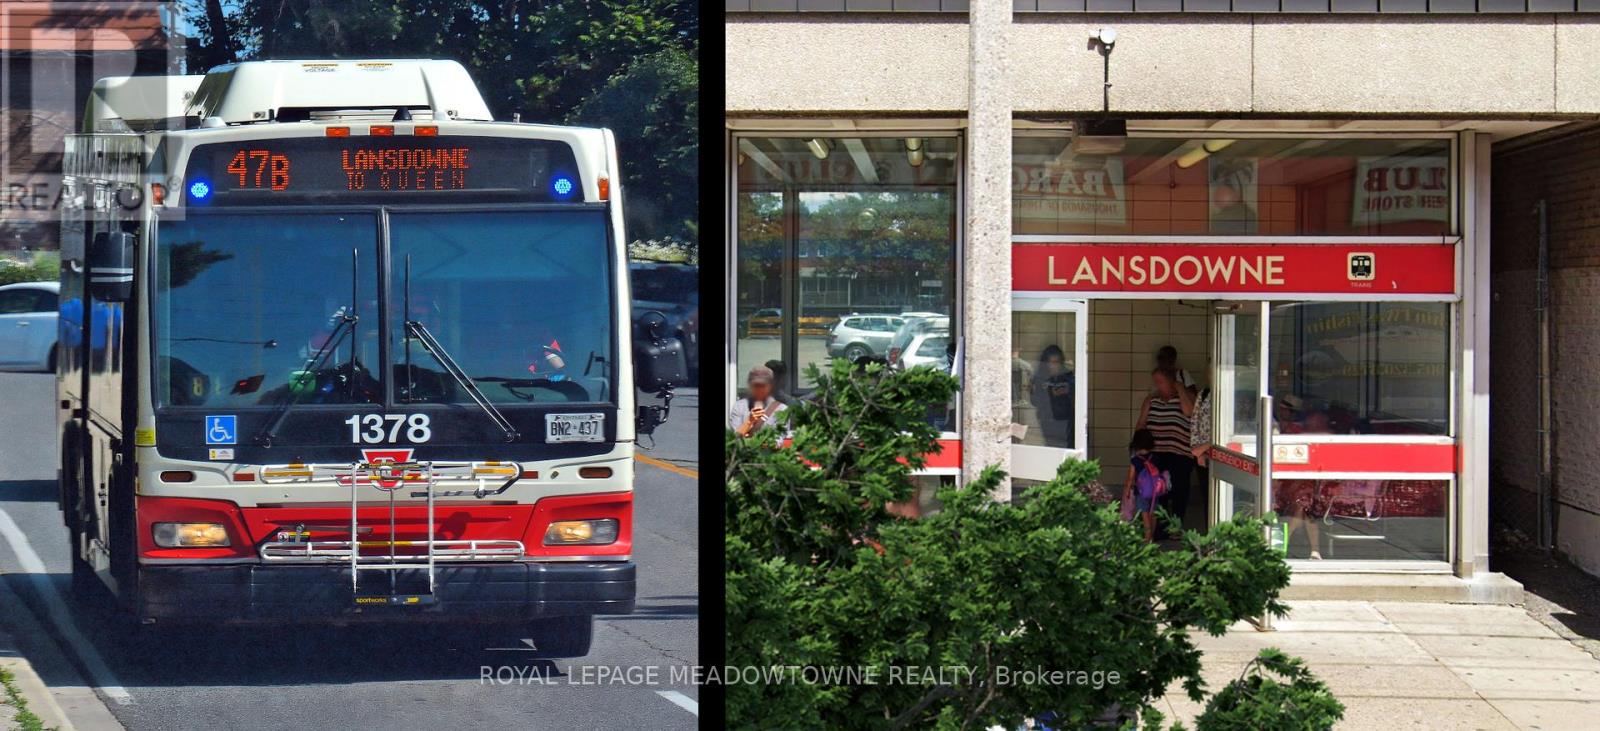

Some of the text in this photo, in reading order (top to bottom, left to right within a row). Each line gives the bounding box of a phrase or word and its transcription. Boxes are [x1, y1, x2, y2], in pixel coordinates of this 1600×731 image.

[227, 149, 470, 191] 47B LANSDOWNE
[345, 171, 465, 190] TO QUEEN
[1048, 255, 1285, 286] LANSDOWNE
[345, 413, 431, 443] 1378
